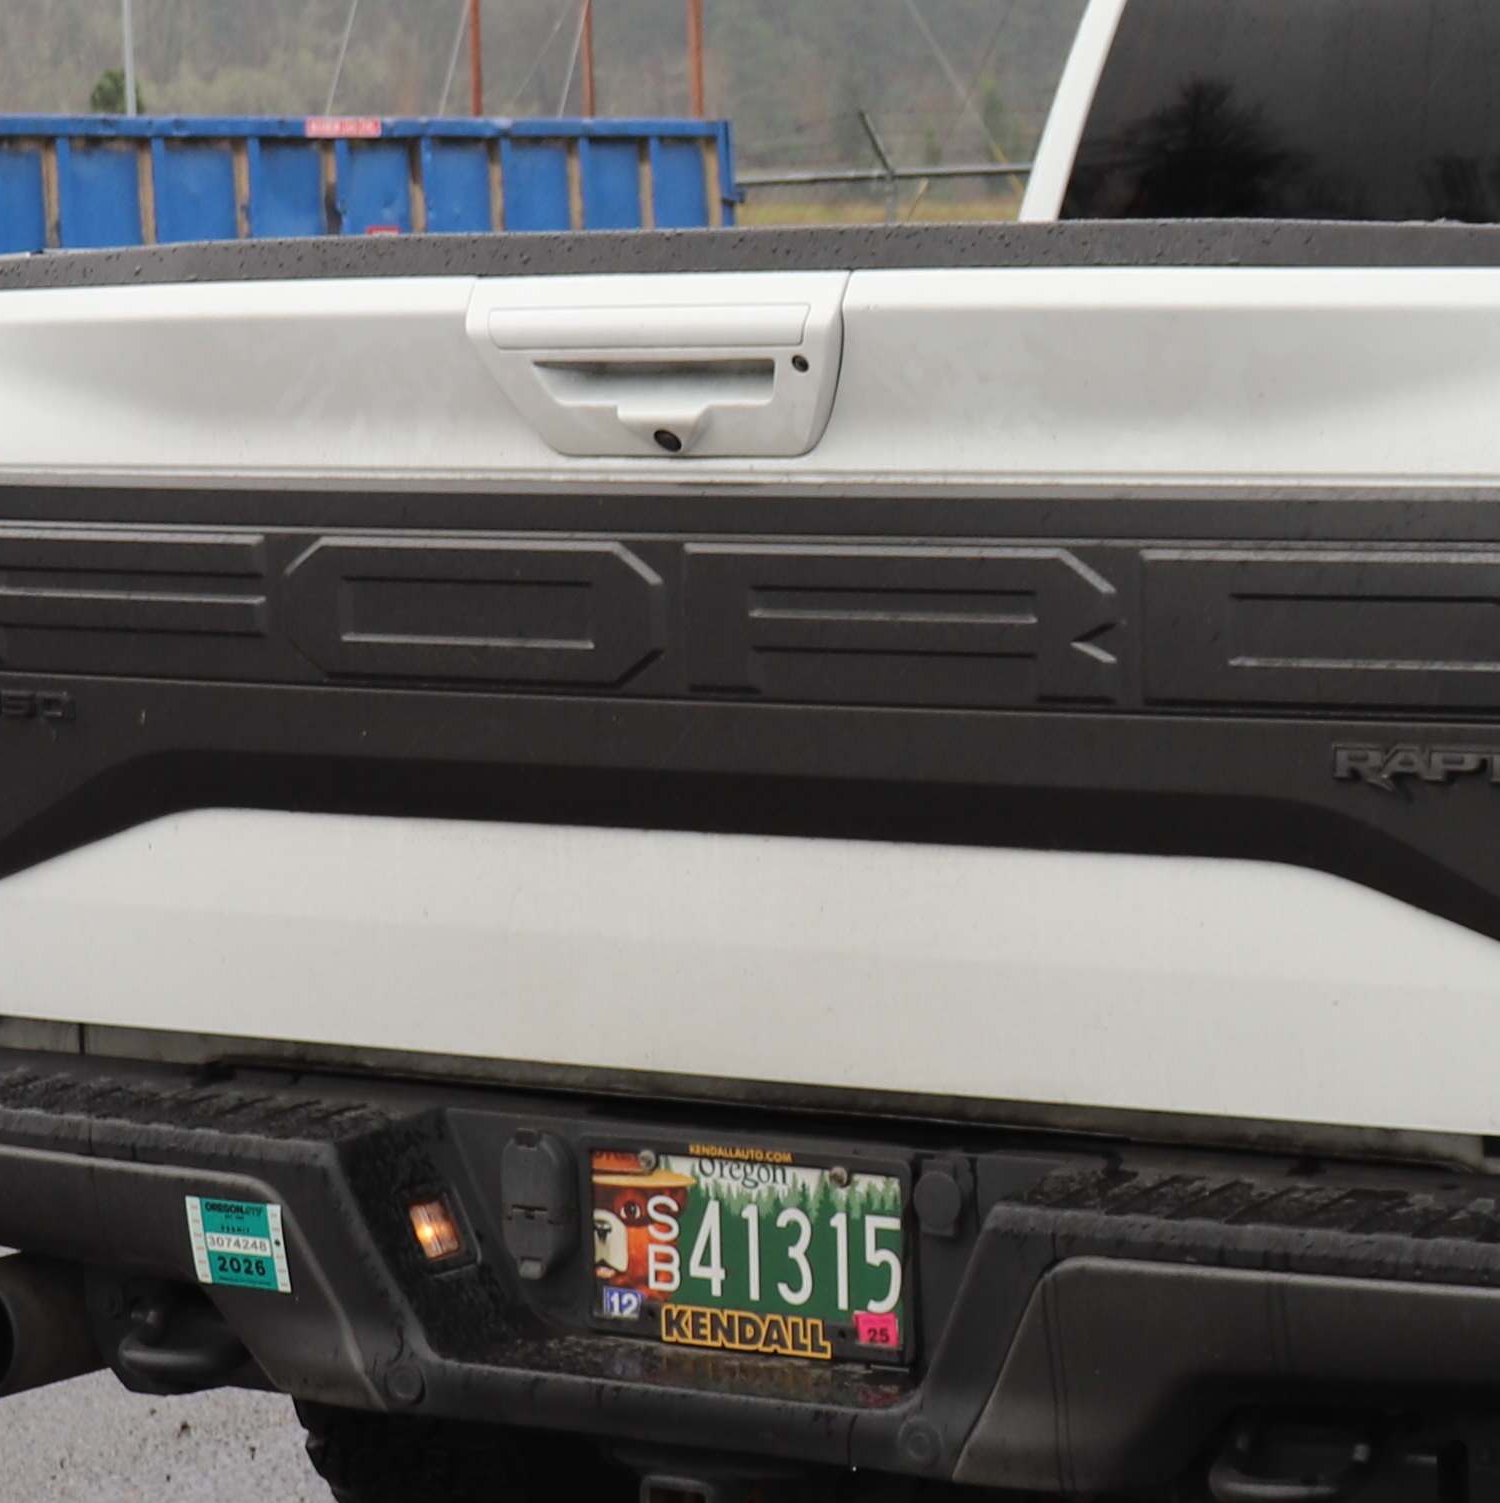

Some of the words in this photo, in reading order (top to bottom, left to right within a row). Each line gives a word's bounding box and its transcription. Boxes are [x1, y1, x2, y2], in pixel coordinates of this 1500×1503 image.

[688, 1143, 794, 1164] KENDALLAUTO.COM
[698, 1157, 788, 1189] Oregon
[217, 1256, 266, 1276] 2026
[689, 1199, 901, 1314] 41315
[609, 1292, 638, 1317] 12
[662, 1304, 831, 1358] KENDALL
[867, 1327, 890, 1344] 25
